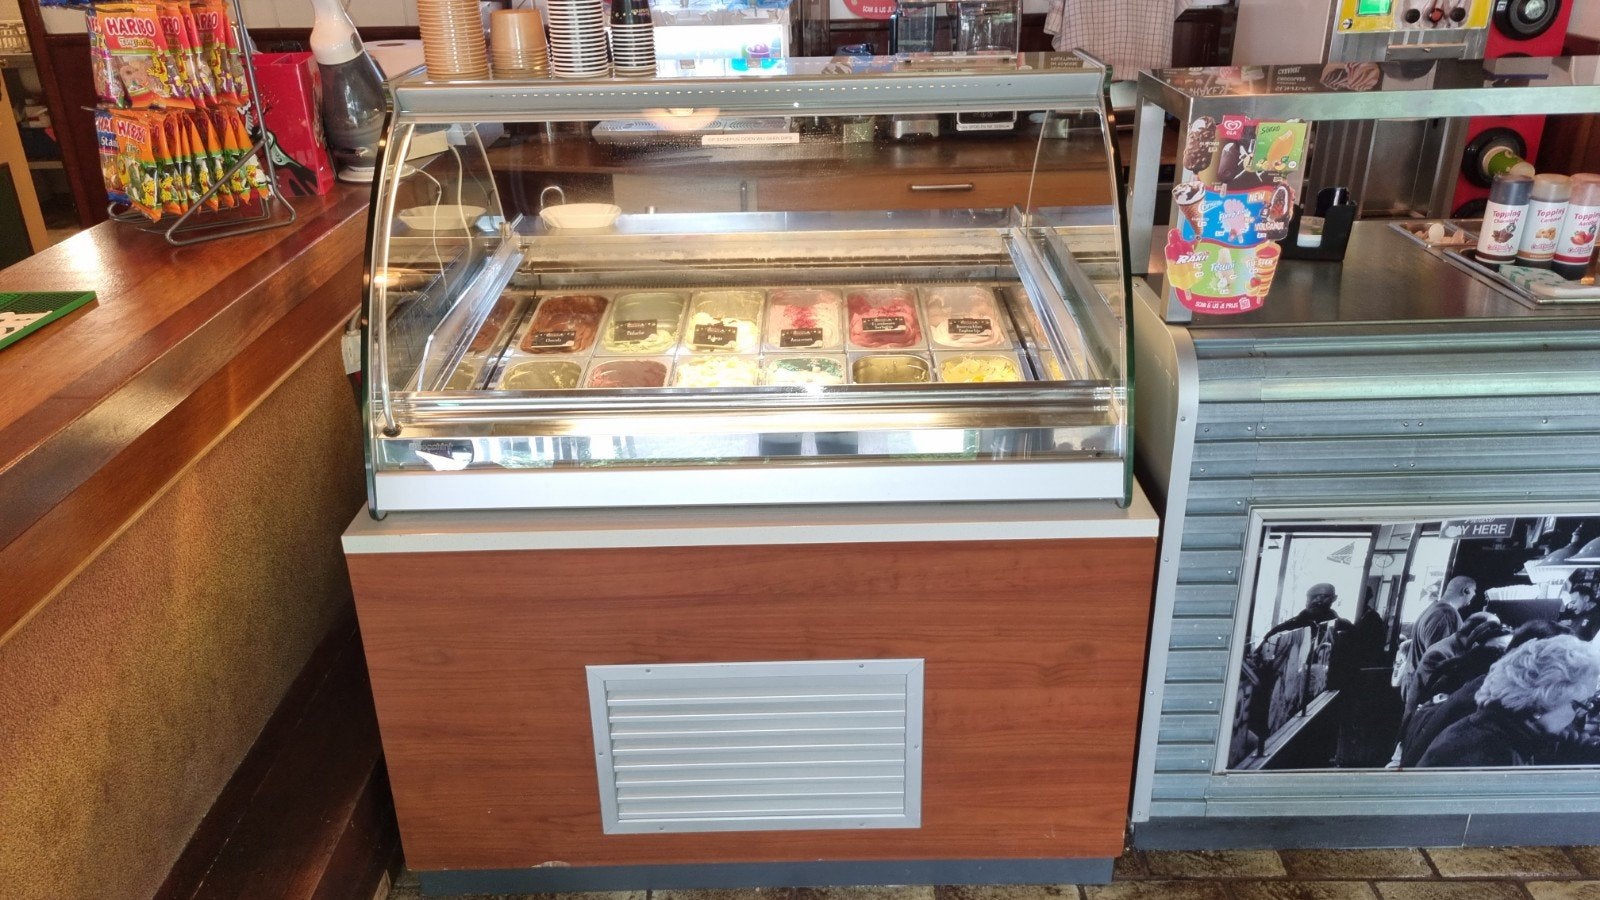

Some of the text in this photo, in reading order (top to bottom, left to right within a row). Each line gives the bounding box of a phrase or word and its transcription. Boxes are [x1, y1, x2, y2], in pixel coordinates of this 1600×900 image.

[105, 17, 156, 37] HARIBO
[1249, 191, 1266, 202] NEW
[1493, 210, 1522, 219] Topping
[1537, 208, 1565, 217] Topping
[1574, 212, 1600, 220] Toppin
[1472, 524, 1507, 535] HERE
